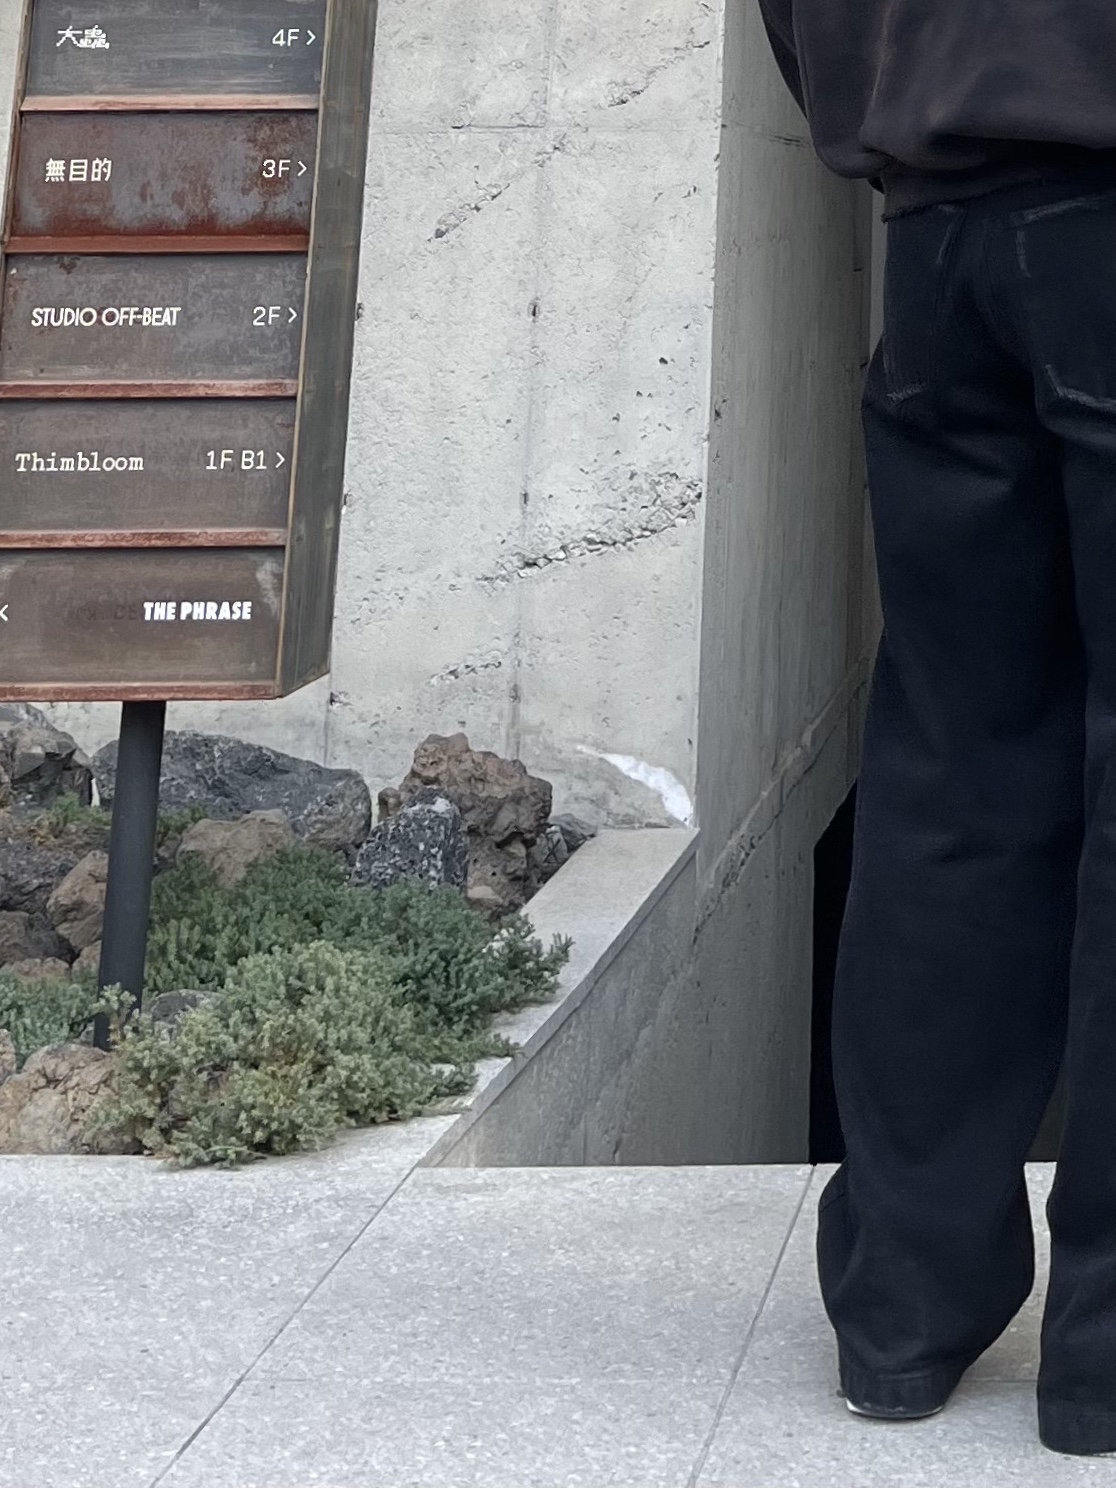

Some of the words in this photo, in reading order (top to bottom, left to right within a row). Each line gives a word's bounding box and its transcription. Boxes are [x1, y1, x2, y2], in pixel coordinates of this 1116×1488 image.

[272, 28, 300, 47] 4F
[44, 157, 112, 183] 無目的
[262, 159, 291, 178] 3F
[31, 307, 97, 327] STUDIO
[101, 306, 182, 327] OFF-BEAT
[252, 306, 281, 326] 2F
[15, 451, 145, 472] Thimbloom
[205, 449, 234, 470] 1F
[241, 449, 267, 470] B1
[143, 601, 177, 621] THE
[180, 601, 252, 621] PHRASE
